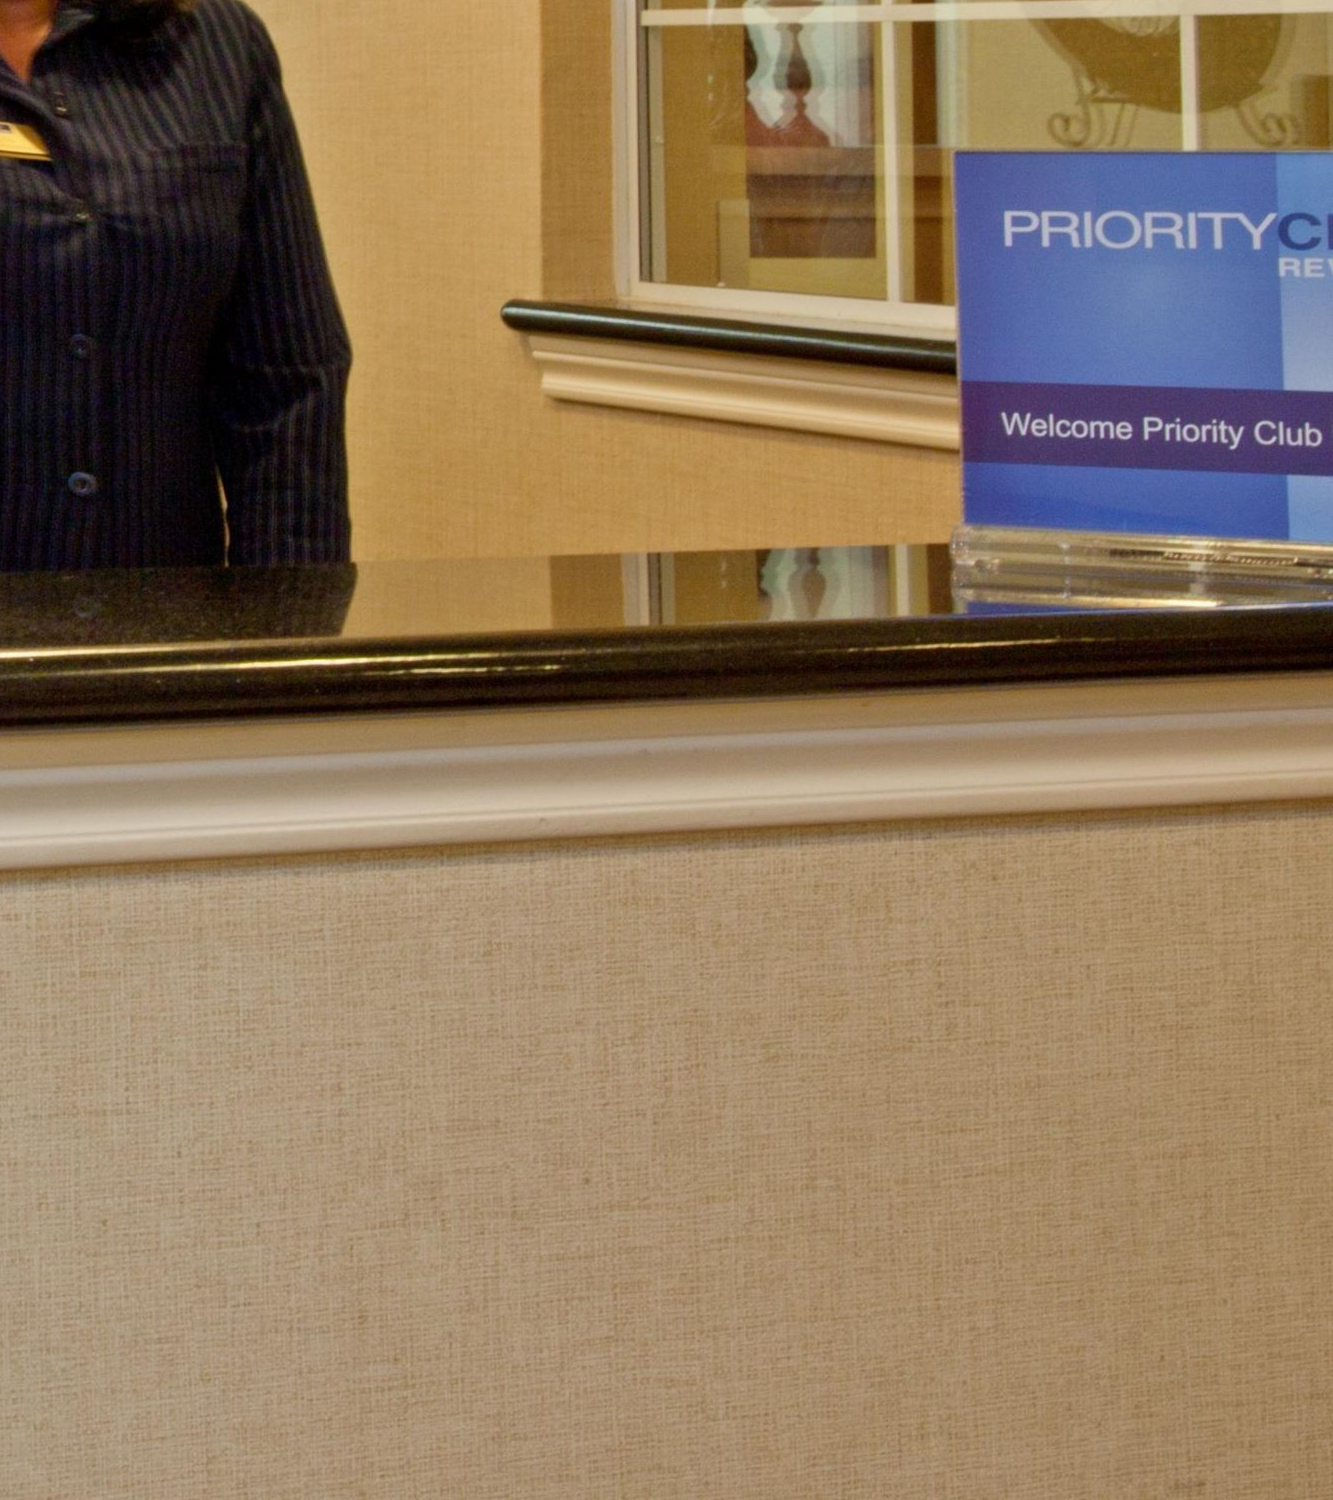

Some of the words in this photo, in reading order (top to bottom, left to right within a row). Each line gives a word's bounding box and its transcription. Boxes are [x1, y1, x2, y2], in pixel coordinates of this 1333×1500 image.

[1001, 412, 1133, 441] Welcome
[1143, 417, 1245, 450] Priority
[1254, 420, 1323, 447] Club
